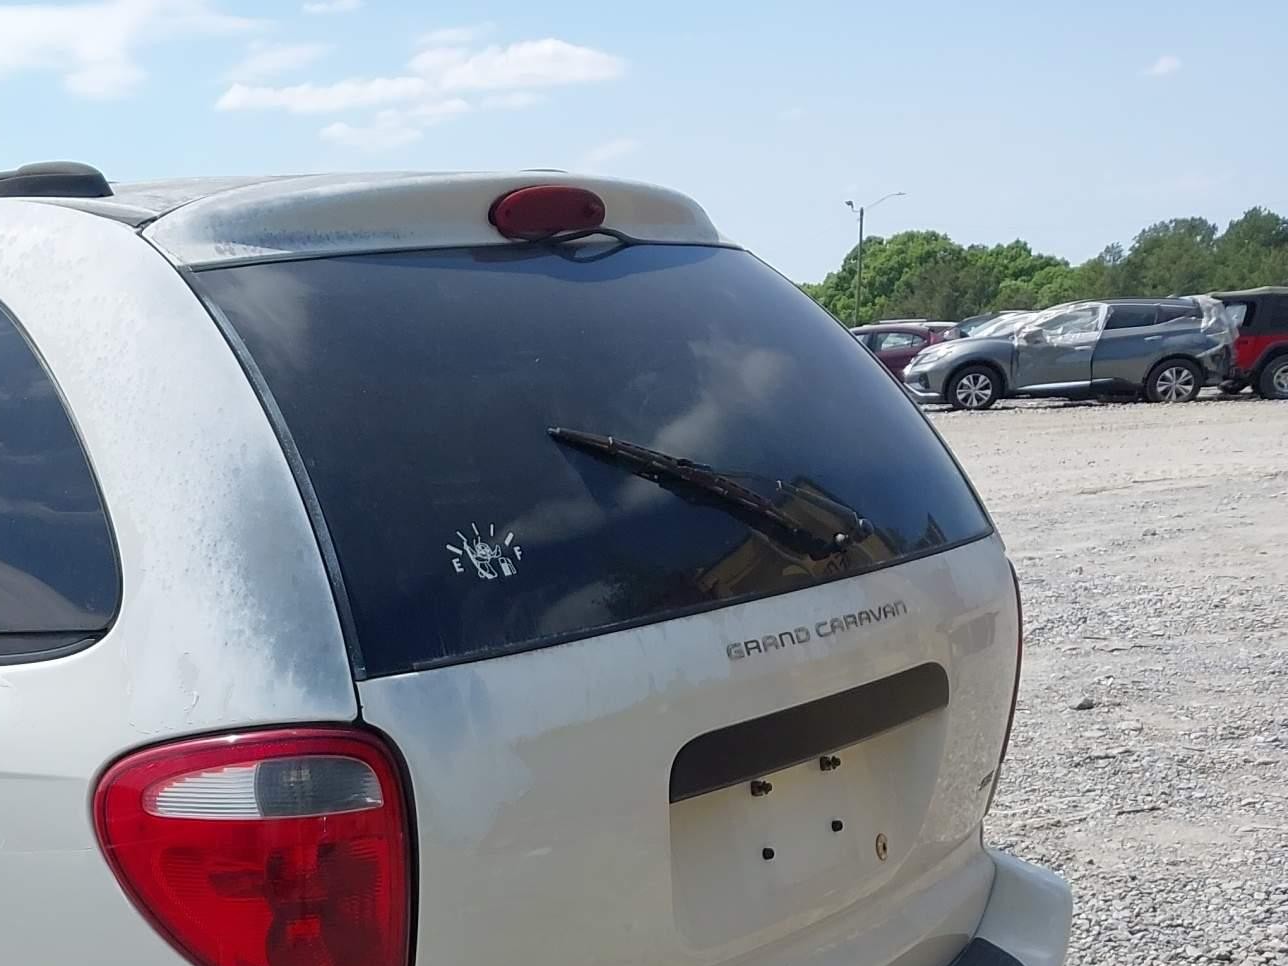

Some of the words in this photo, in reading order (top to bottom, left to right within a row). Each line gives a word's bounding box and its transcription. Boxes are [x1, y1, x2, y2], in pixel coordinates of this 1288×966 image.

[452, 557, 464, 572] E
[726, 626, 811, 661] GRAND
[814, 599, 908, 638] CARAVAN
